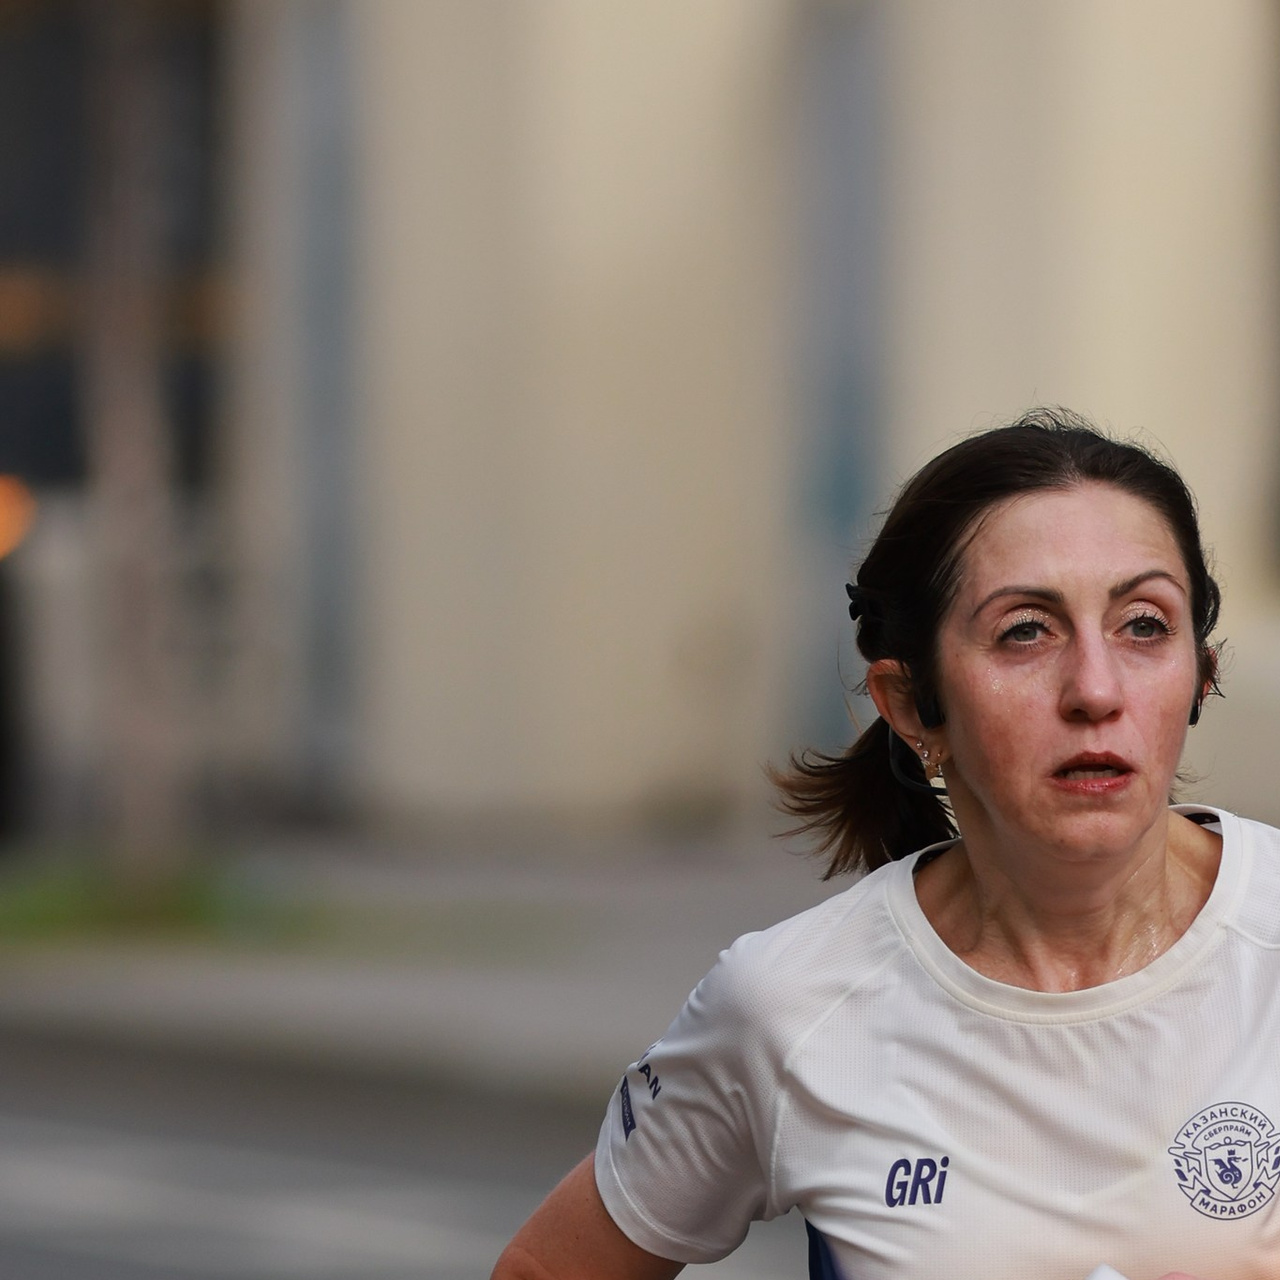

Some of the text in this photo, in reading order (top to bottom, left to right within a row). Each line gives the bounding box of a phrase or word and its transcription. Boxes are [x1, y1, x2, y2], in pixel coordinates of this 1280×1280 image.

[1183, 1107, 1267, 1139] КАЗАНСКИЙ
[1203, 1124, 1252, 1141] СБЕРПРАЙМ
[1199, 1191, 1266, 1216] МАРАФОН
